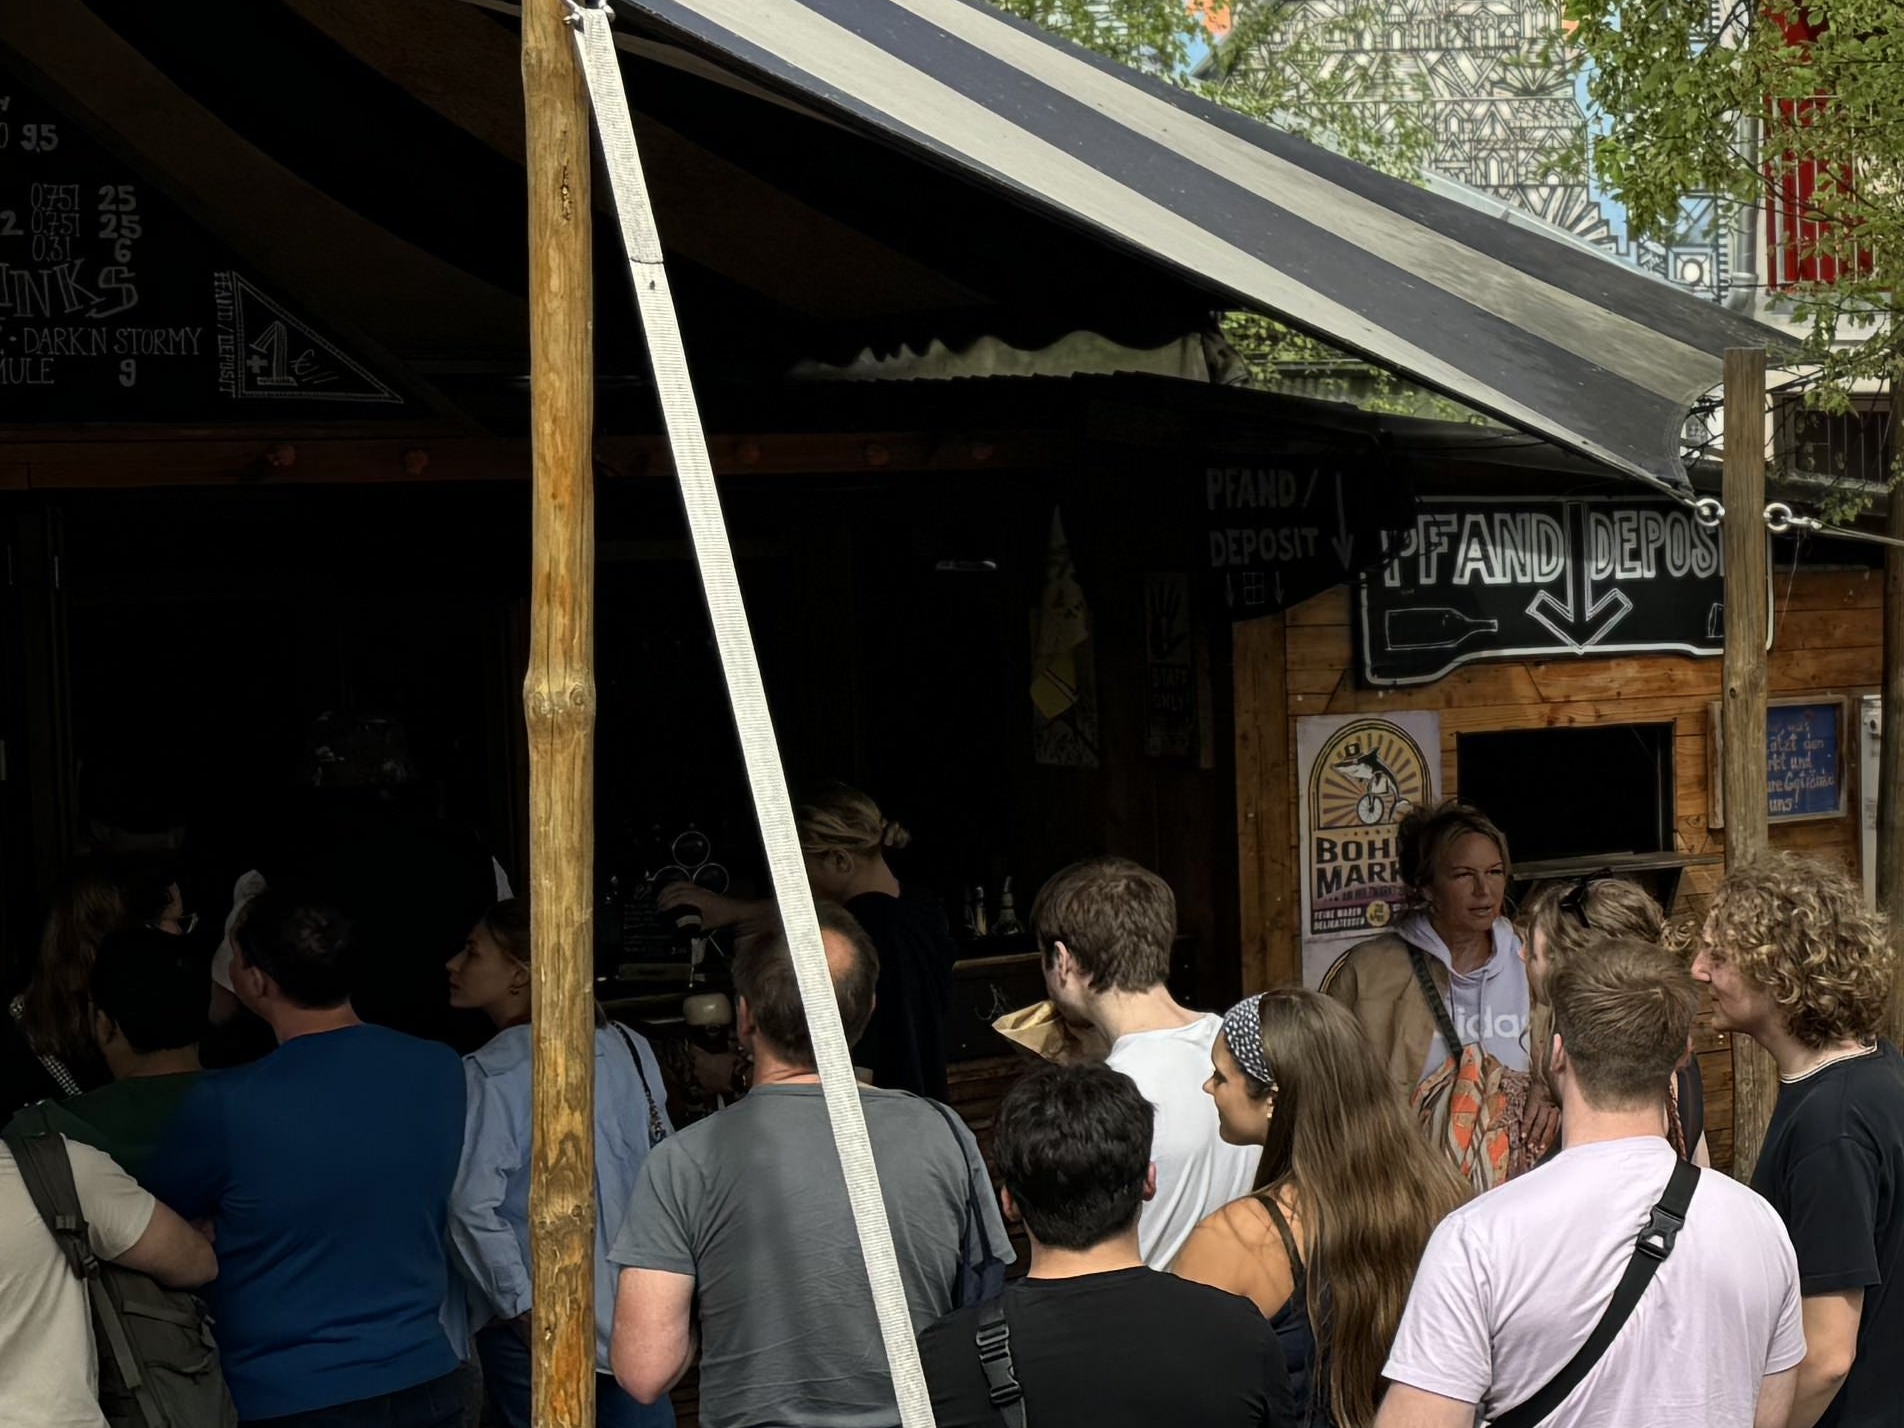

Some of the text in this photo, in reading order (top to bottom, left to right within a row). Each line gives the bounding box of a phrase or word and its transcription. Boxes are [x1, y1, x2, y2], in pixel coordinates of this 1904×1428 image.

[97, 184, 137, 212] 25
[98, 213, 143, 239] 25
[114, 237, 133, 264] 6
[113, 326, 204, 356] STORMY
[118, 358, 137, 388] 9
[1208, 526, 1320, 568] DEPOSIT
[1381, 513, 1567, 587] PFAND
